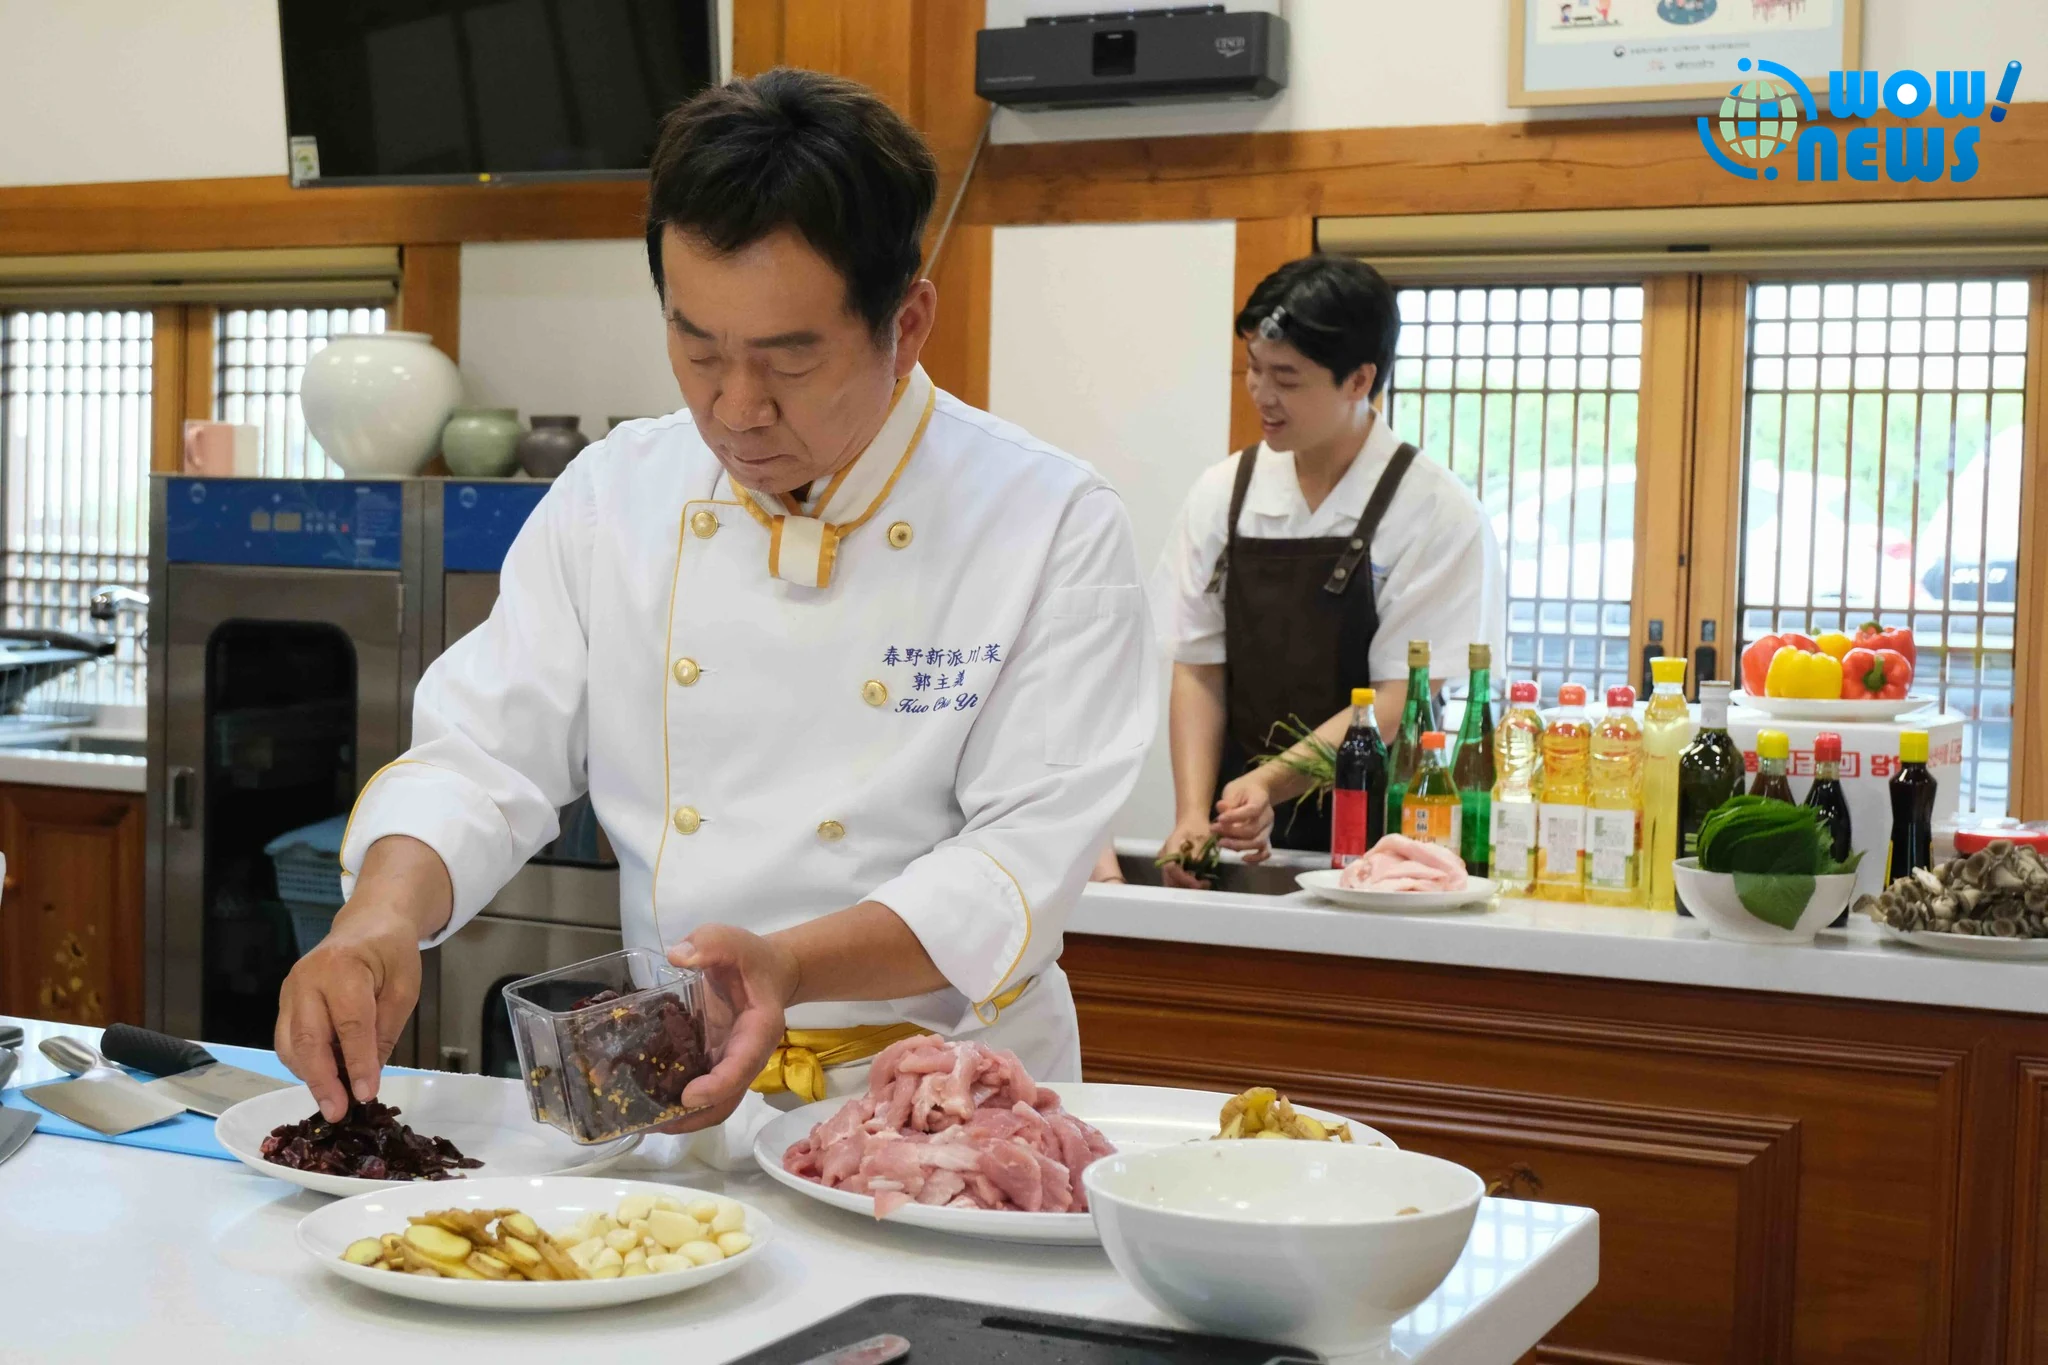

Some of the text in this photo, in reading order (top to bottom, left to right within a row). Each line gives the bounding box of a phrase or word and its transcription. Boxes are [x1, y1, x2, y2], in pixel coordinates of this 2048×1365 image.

[882, 643, 1002, 668] 春野新派川菜
[894, 698, 929, 714] Kuo
[954, 692, 979, 712] Yi
